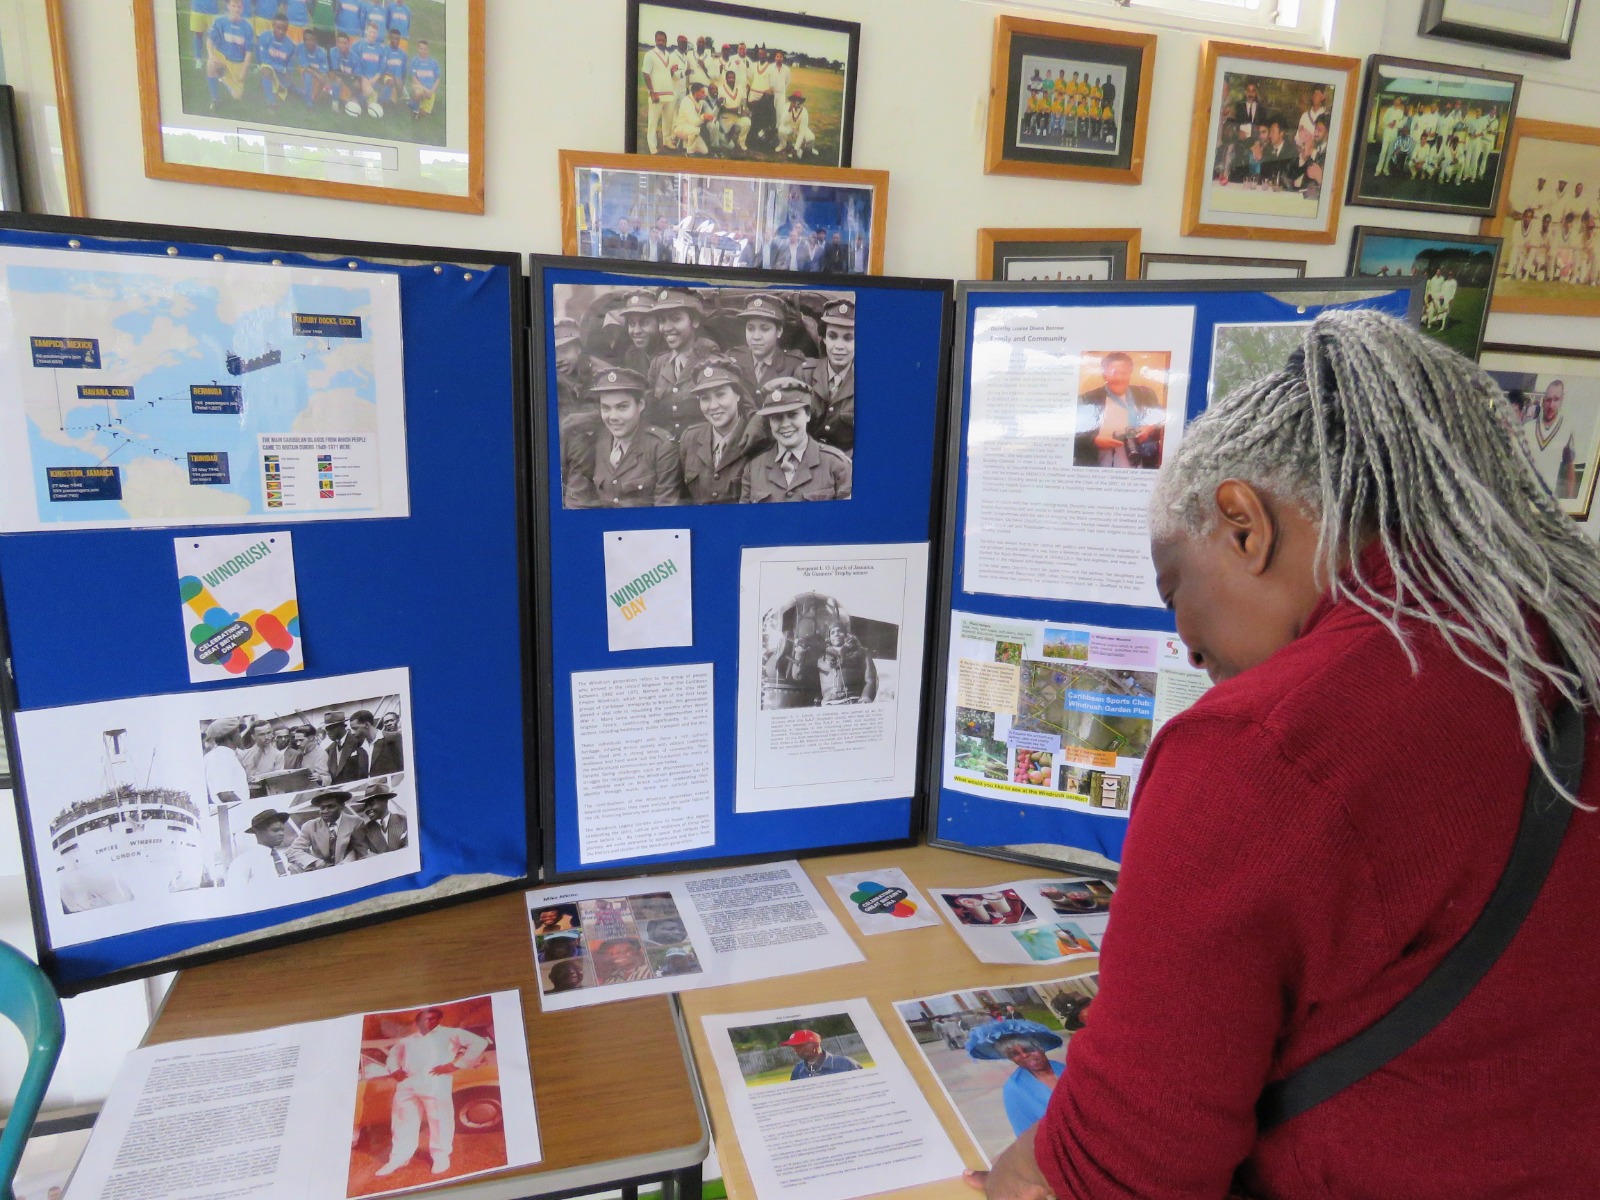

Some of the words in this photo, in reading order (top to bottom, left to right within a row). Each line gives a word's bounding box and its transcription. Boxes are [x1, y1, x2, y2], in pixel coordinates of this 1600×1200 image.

[1027, 335, 1067, 344] Community
[112, 388, 129, 397] CUBA
[202, 541, 271, 588] WINDRUSH
[610, 559, 678, 608] WINDRUSH
[620, 595, 647, 621] DAY
[198, 623, 241, 652] CELEBRATING
[199, 644, 220, 660] GREAT
[219, 626, 249, 647] BRITAIN'S
[221, 642, 238, 654] DNA
[1067, 691, 1104, 703] Caribbean
[1106, 696, 1130, 706] Sports
[1132, 698, 1152, 707] Club:
[1068, 700, 1103, 711] Windrush
[1104, 705, 1131, 714] Garden
[1133, 706, 1150, 715] Plan
[968, 778, 983, 787] would
[1039, 789, 1065, 798] Windrush
[95, 844, 118, 854] EMPIRE
[111, 850, 141, 861] LONDON
